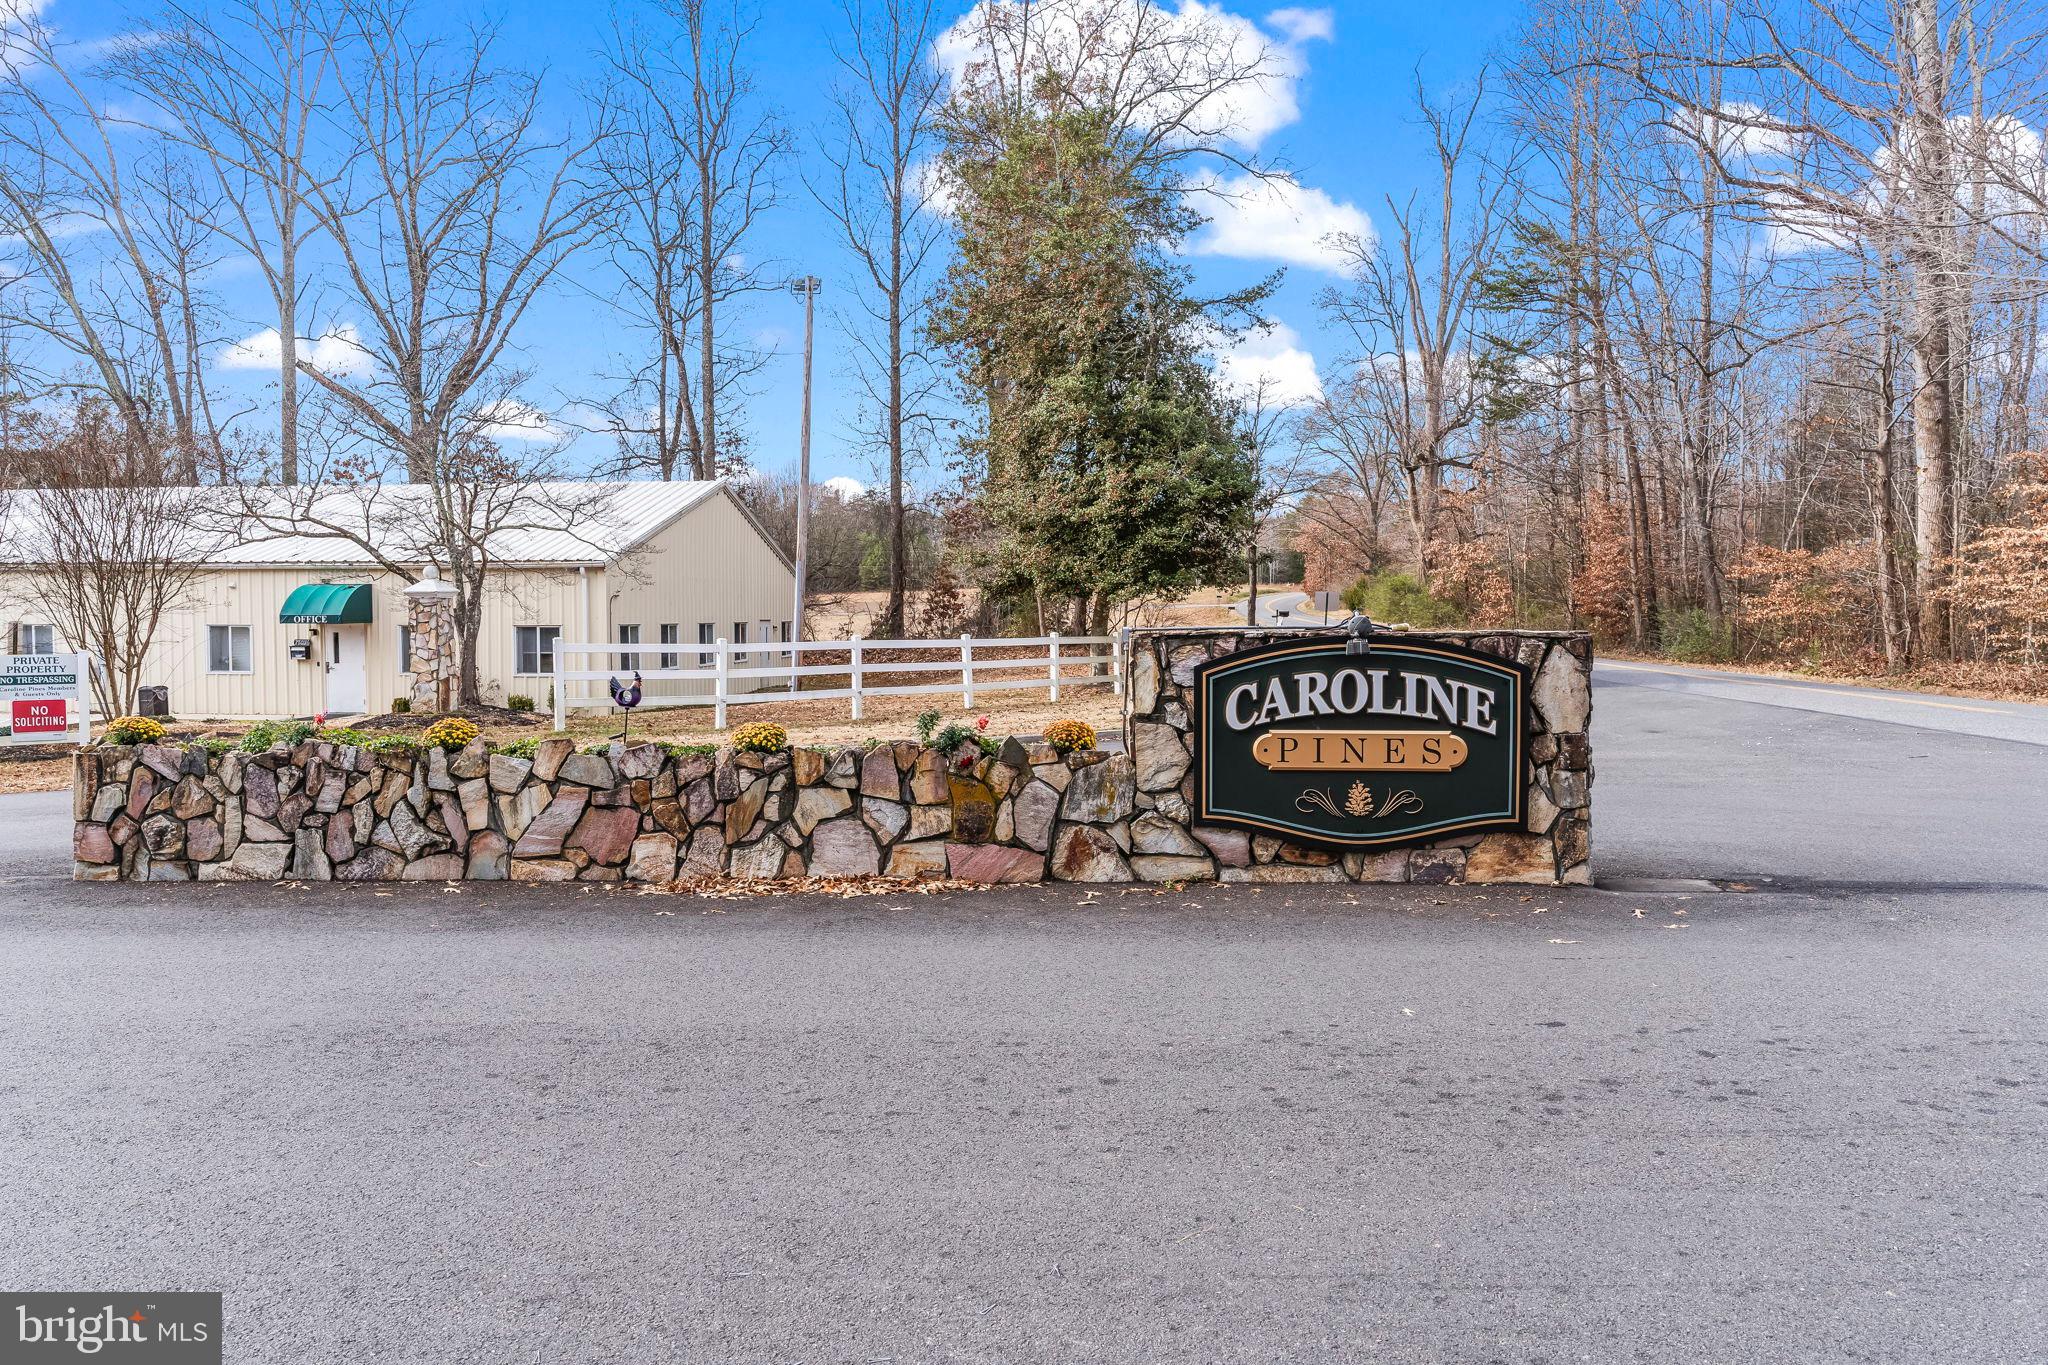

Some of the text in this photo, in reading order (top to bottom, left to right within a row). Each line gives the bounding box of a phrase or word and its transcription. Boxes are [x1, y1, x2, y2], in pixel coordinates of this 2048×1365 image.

[31, 706, 49, 715] NO
[1225, 668, 1497, 735] CAROLINE
[15, 716, 65, 726] SOLICITING
[1276, 737, 1442, 764] PINES
